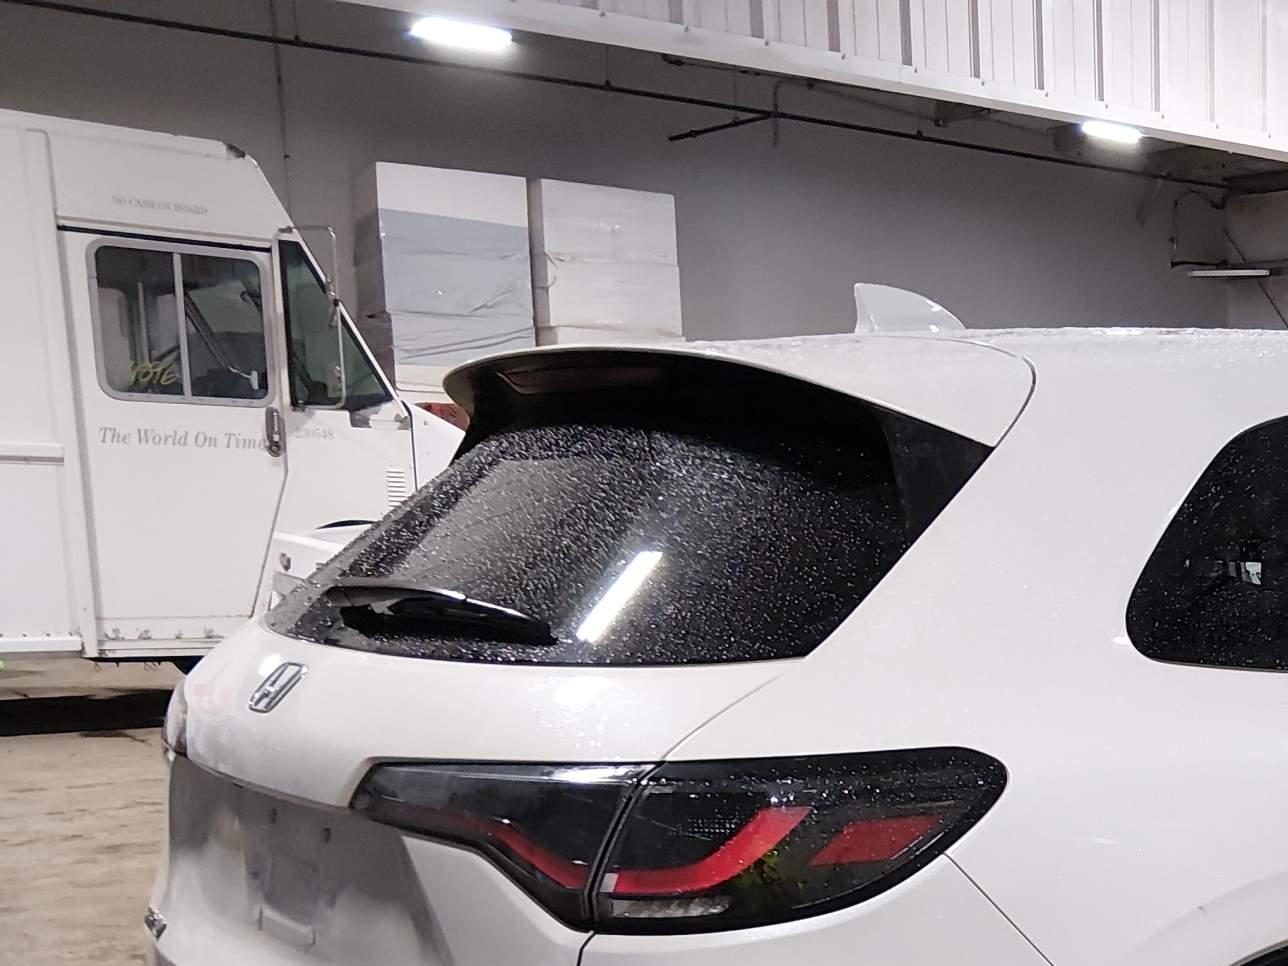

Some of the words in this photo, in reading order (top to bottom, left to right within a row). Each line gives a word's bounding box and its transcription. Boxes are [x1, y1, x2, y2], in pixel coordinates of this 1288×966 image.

[98, 426, 130, 446] The
[136, 428, 188, 448] World
[194, 432, 218, 449] On
